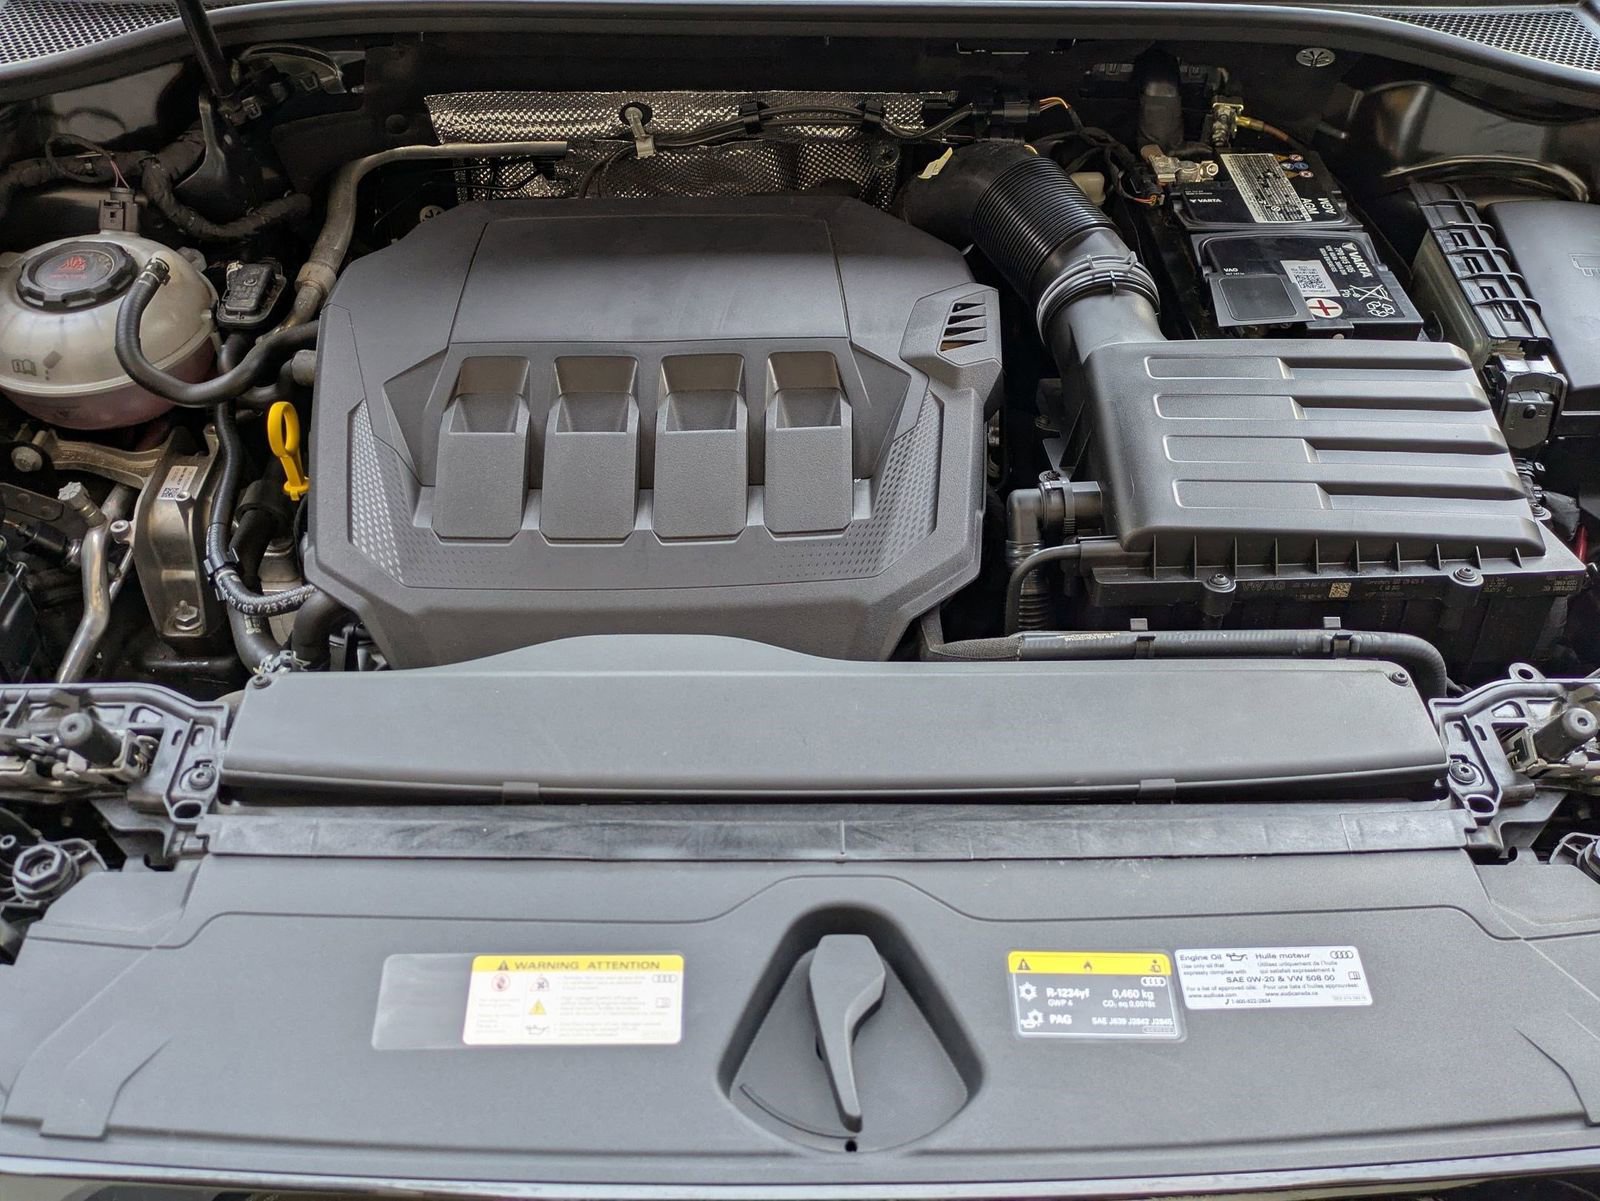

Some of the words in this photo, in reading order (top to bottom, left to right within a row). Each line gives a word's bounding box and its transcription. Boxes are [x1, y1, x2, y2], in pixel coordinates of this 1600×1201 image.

[1300, 198, 1320, 215] AGM
[1318, 198, 1339, 215] AGM
[1349, 252, 1373, 278] VARTA
[1180, 954, 1208, 962] Engine
[515, 961, 579, 970] WARNING
[587, 961, 660, 970] ATTENTION
[1047, 988, 1090, 1000] R-1234yf
[1142, 990, 1154, 1001] kg
[1050, 1014, 1072, 1025] PAG
